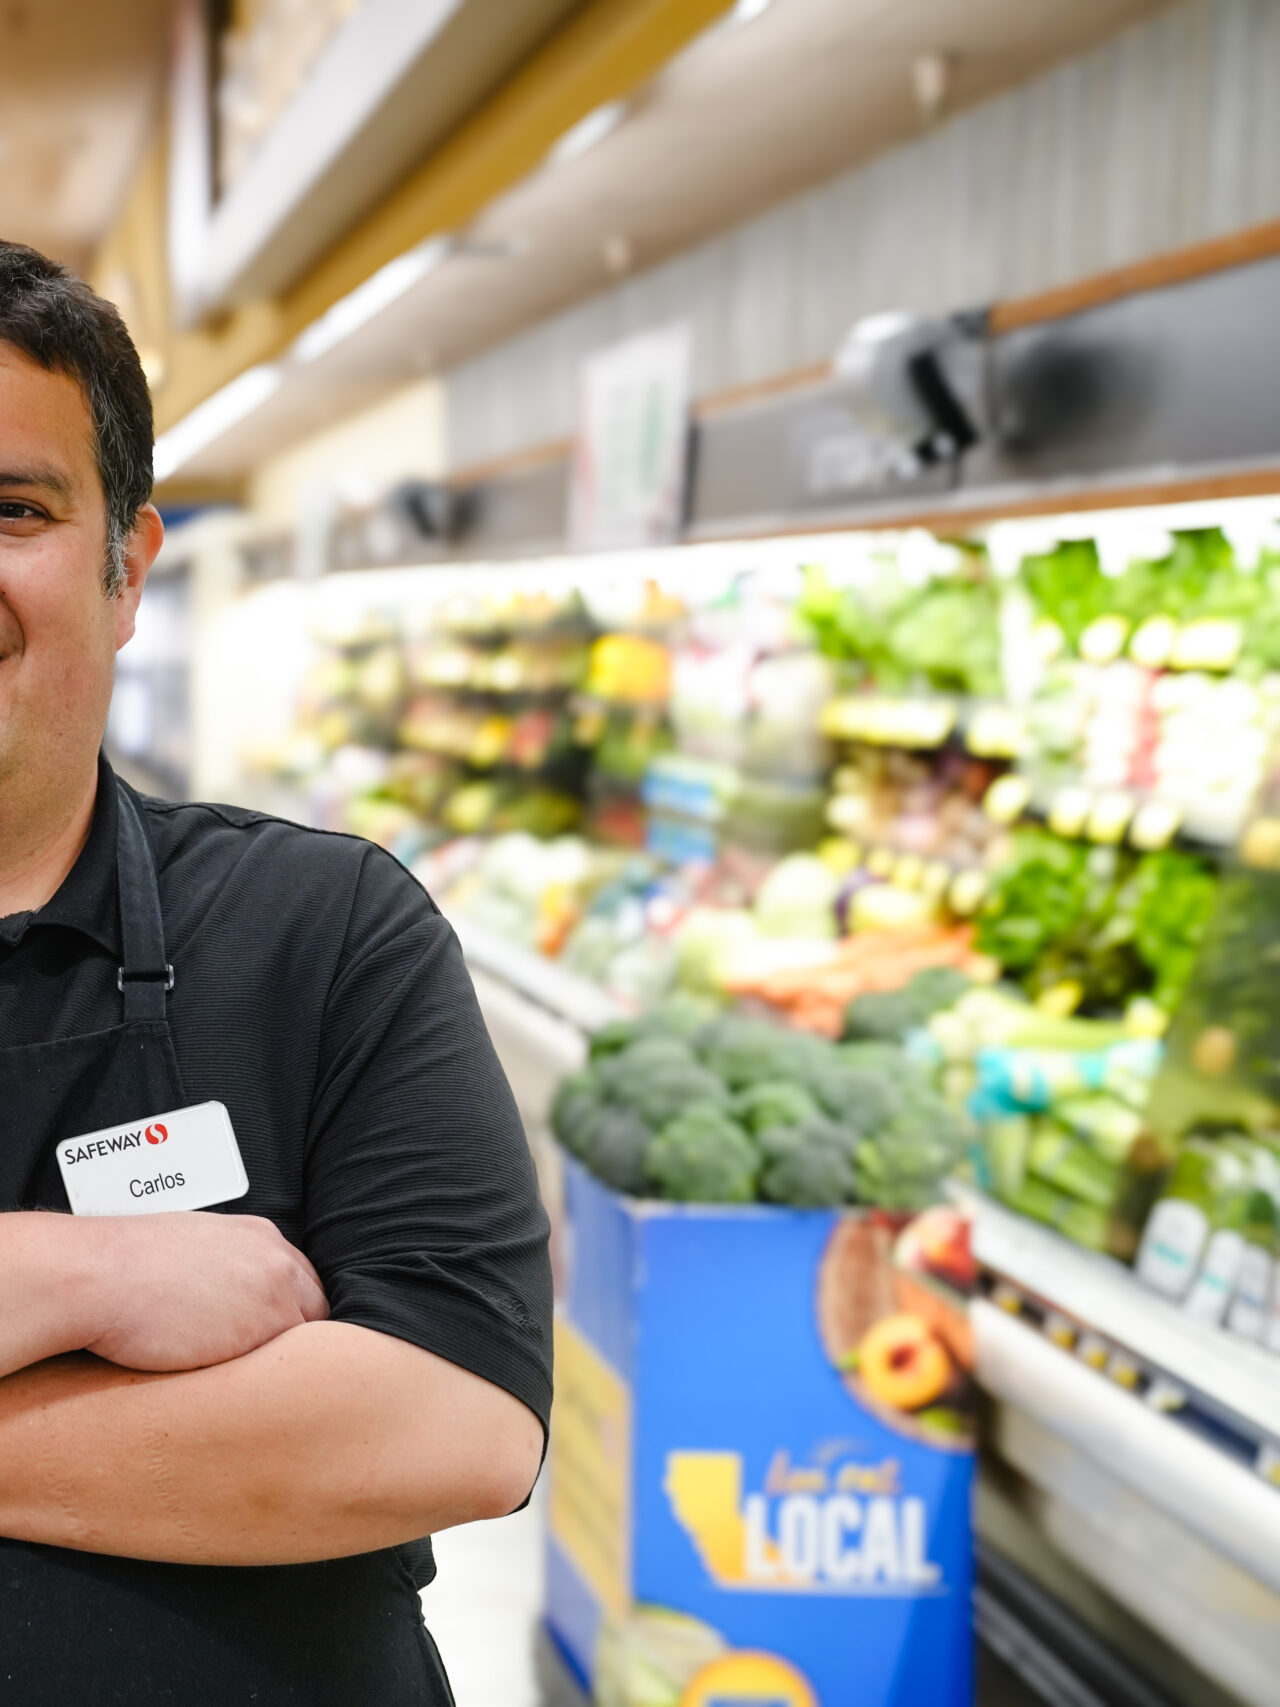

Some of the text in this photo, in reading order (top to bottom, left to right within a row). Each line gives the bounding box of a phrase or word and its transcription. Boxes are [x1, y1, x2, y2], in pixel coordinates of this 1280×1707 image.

[64, 1130, 142, 1166] SAFEWAY
[128, 1172, 187, 1198] Carlos
[745, 1493, 943, 1580] LOCAL
